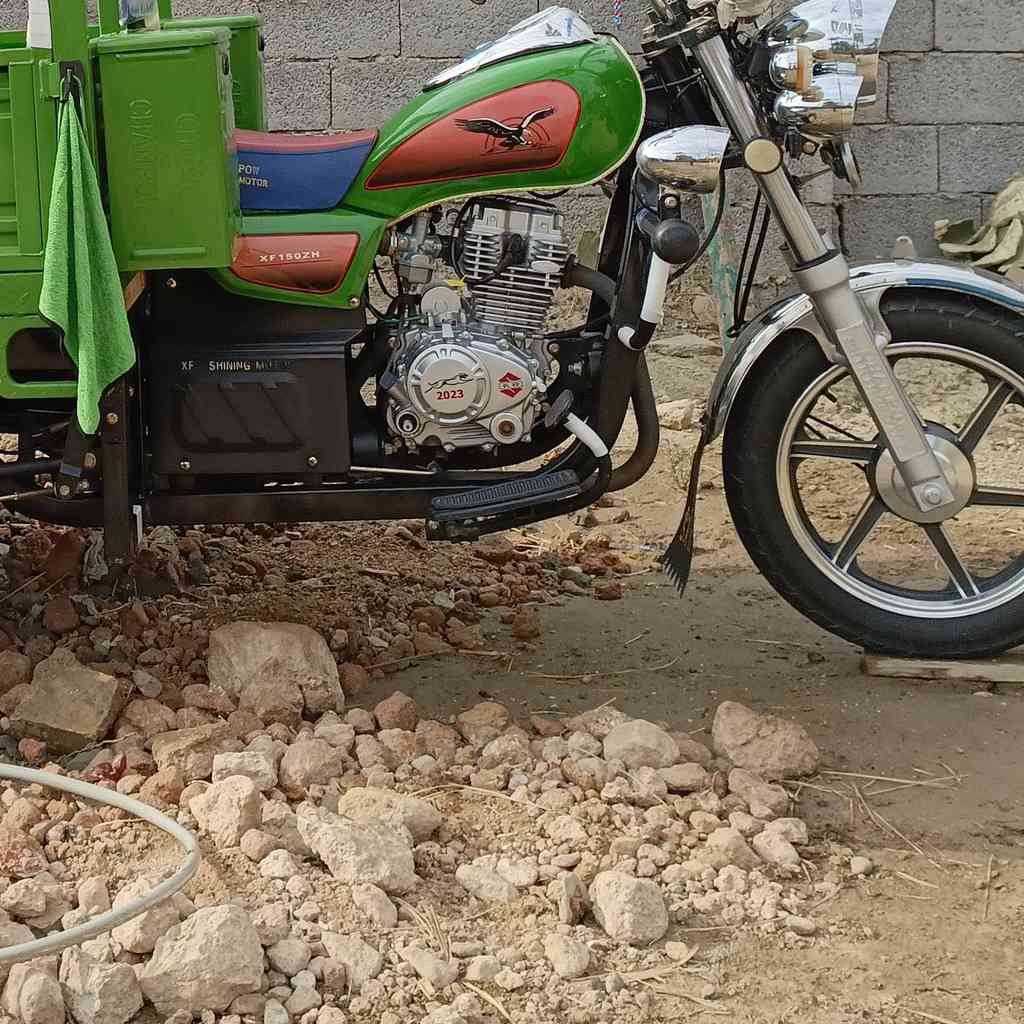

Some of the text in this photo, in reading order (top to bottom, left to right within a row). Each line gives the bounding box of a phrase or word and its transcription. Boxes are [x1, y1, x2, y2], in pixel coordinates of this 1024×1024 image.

[239, 176, 269, 188] MOTOR
[181, 361, 195, 371] XF
[208, 360, 252, 372] SHINING
[436, 389, 465, 401] 2023
